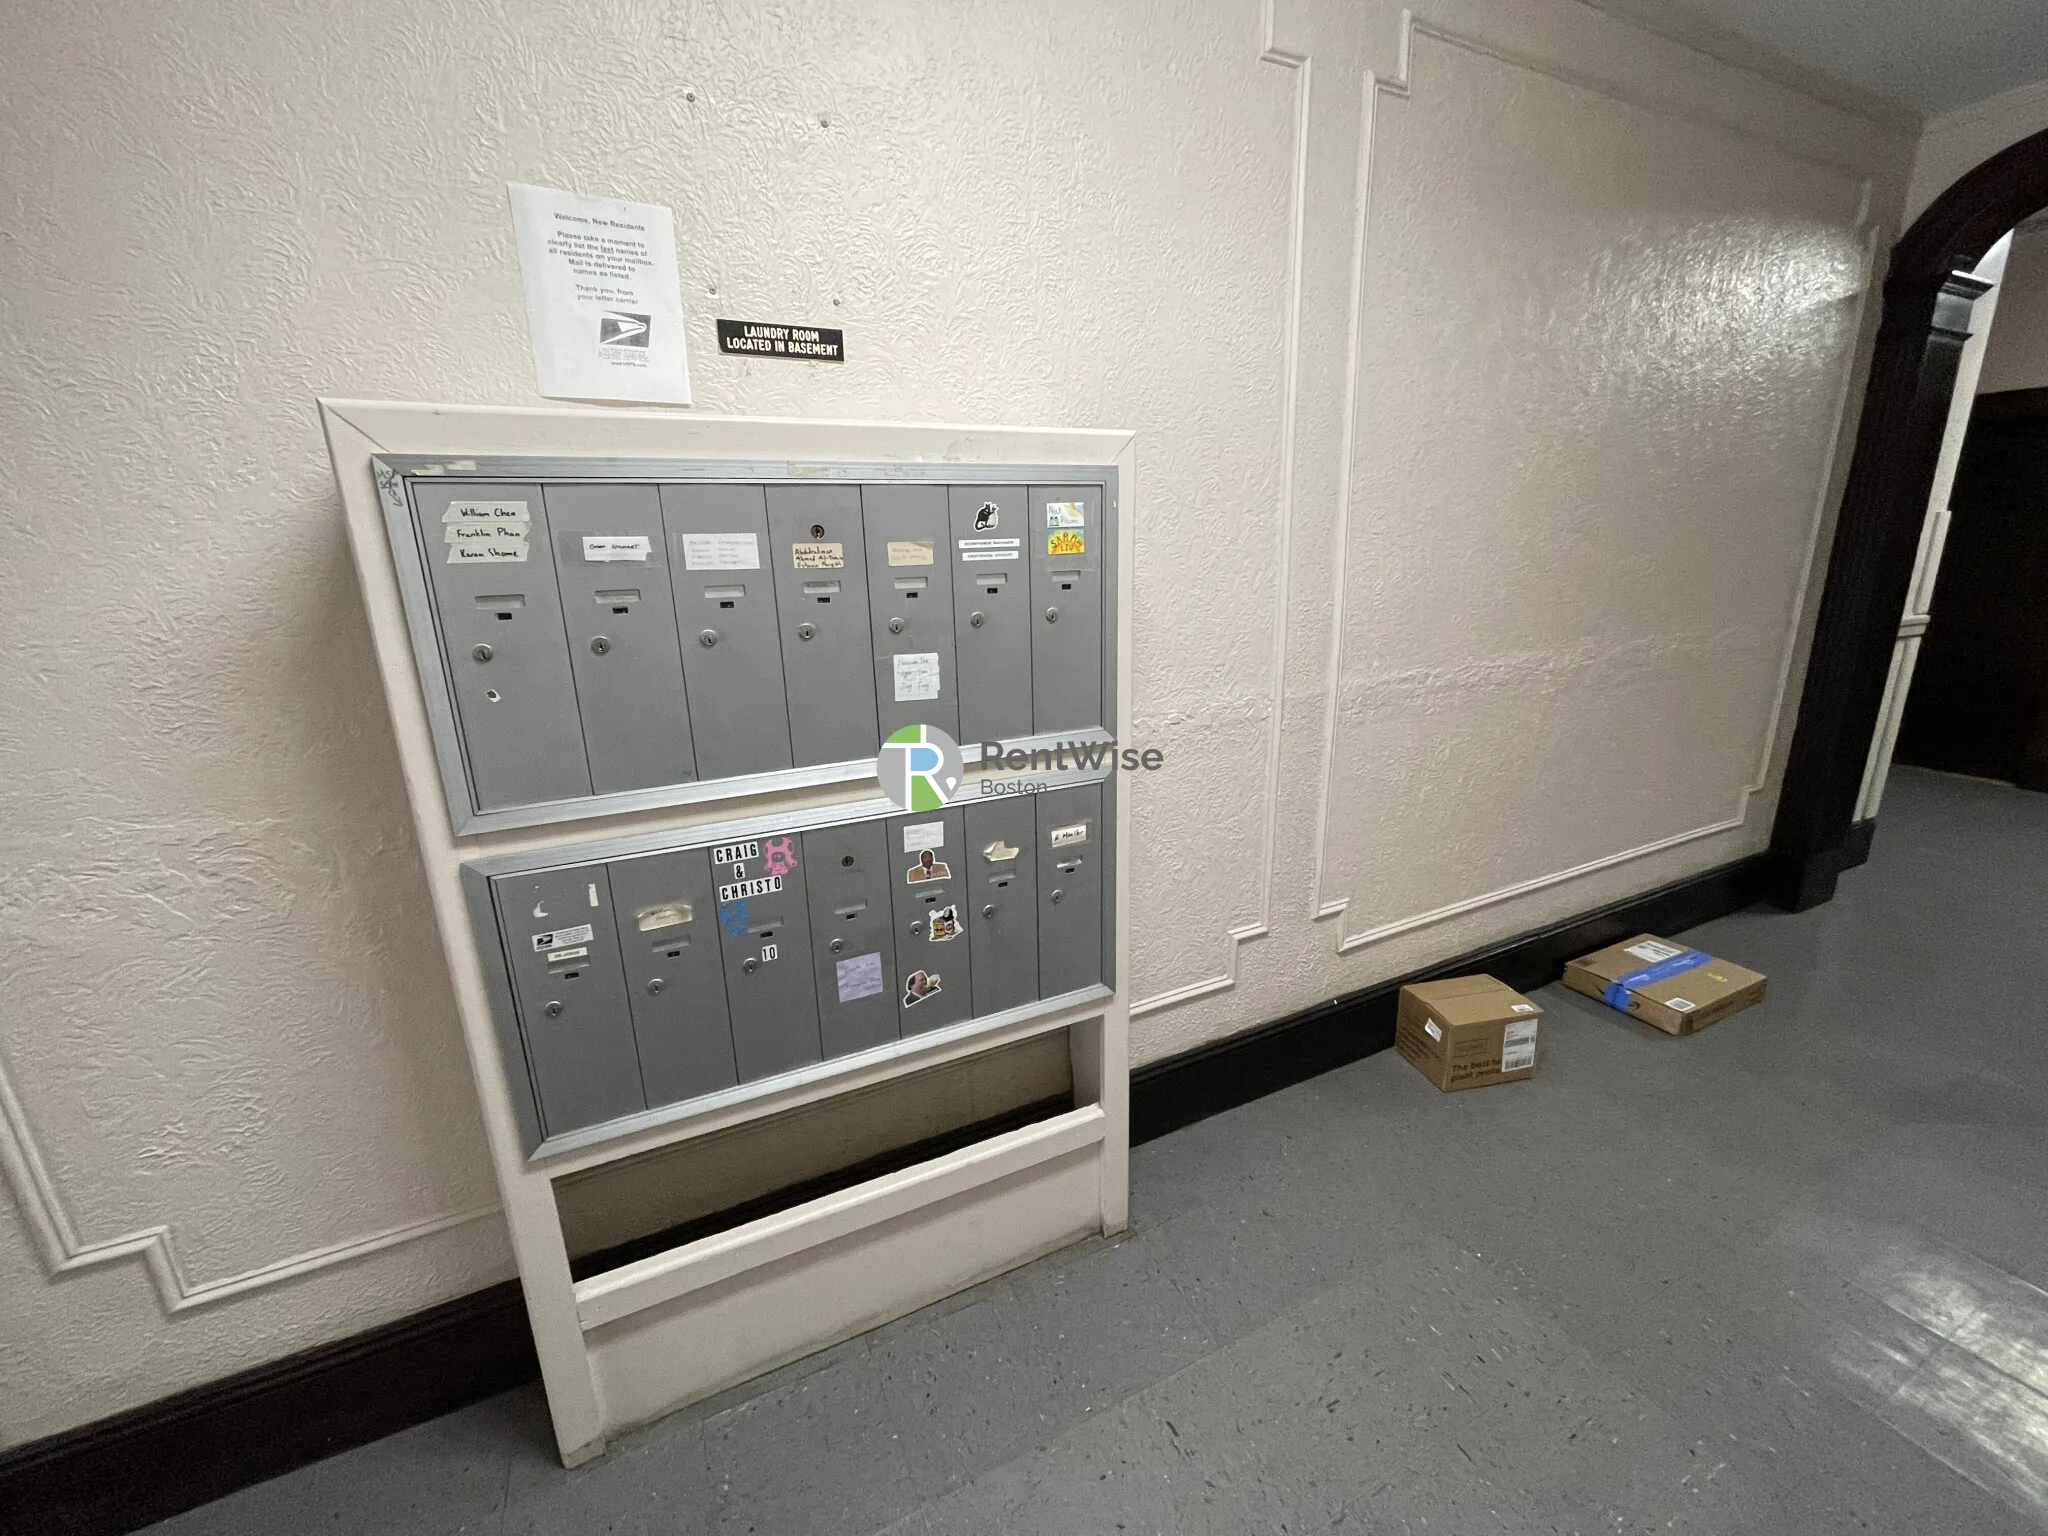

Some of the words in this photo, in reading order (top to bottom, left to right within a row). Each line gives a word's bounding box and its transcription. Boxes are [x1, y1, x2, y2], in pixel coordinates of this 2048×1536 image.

[553, 212, 591, 224] Welcome,
[592, 218, 608, 226] New
[610, 220, 645, 231] Residents
[557, 230, 581, 240] Please
[583, 234, 599, 243] take
[607, 238, 636, 247] moment
[547, 239, 572, 249] clearly
[600, 246, 614, 254] last
[616, 247, 639, 256] names
[560, 249, 593, 259] residents
[607, 255, 622, 263] your
[624, 257, 654, 266] mailbox.
[568, 258, 583, 266] Mail
[594, 261, 627, 271] delivered
[573, 268, 597, 276] names
[609, 271, 632, 280] listed.
[576, 284, 598, 292] Thank
[600, 287, 615, 295] you,
[617, 287, 634, 296] from
[595, 294, 613, 302] letter
[615, 297, 639, 305] carrier
[743, 325, 789, 340] LAUNDRY
[792, 329, 820, 342] ROOM
[726, 336, 772, 352] LOCATED
[774, 340, 785, 353] IN
[788, 341, 838, 356] BASEMENT
[460, 508, 490, 517] William
[494, 507, 516, 517] Chen
[456, 529, 491, 538] Franklin
[496, 526, 521, 537] Phan
[715, 844, 757, 863] CRAIG
[735, 865, 743, 878] &
[721, 876, 781, 900] CHRISTO
[763, 947, 776, 960] 10
